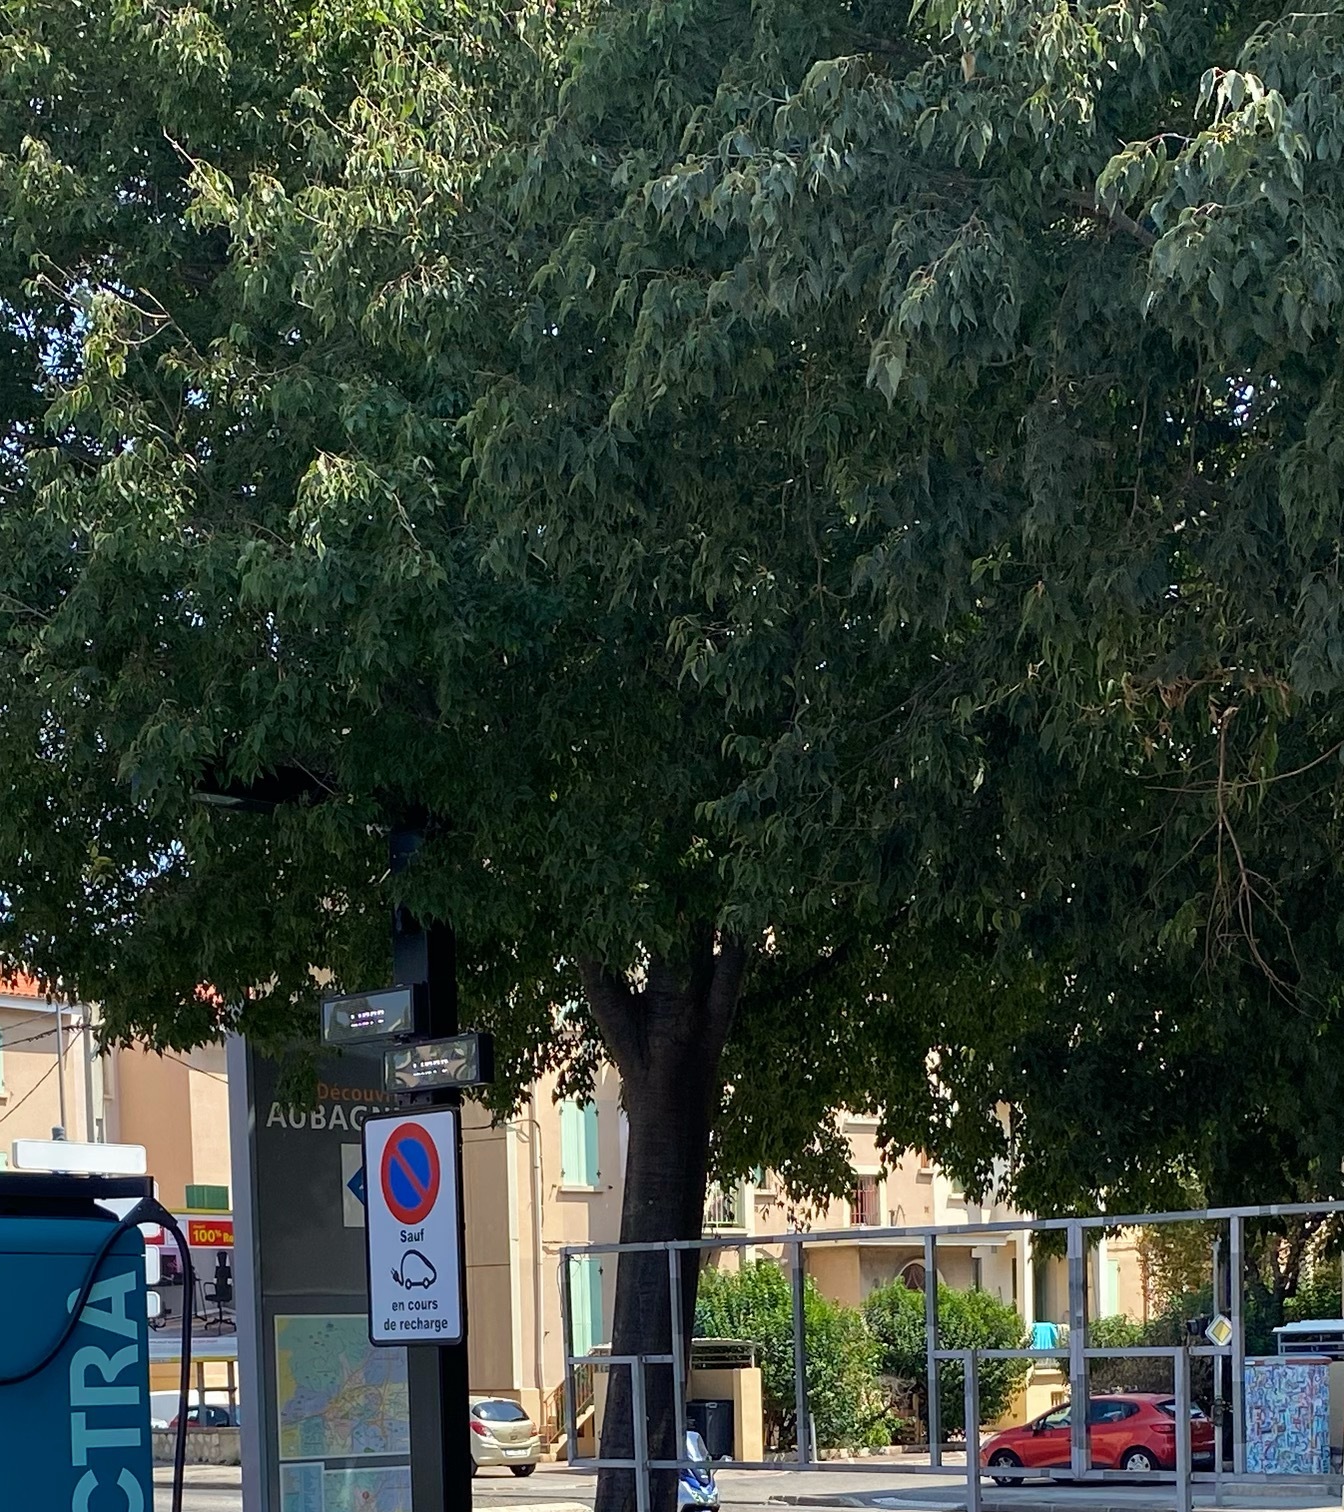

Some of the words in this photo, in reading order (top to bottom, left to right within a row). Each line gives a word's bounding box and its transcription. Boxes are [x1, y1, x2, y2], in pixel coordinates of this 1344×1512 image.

[399, 1228, 425, 1243] Sauf
[391, 1301, 405, 1312] en
[407, 1299, 439, 1311] cours
[383, 1317, 397, 1331] de
[399, 1316, 449, 1333] recharge
